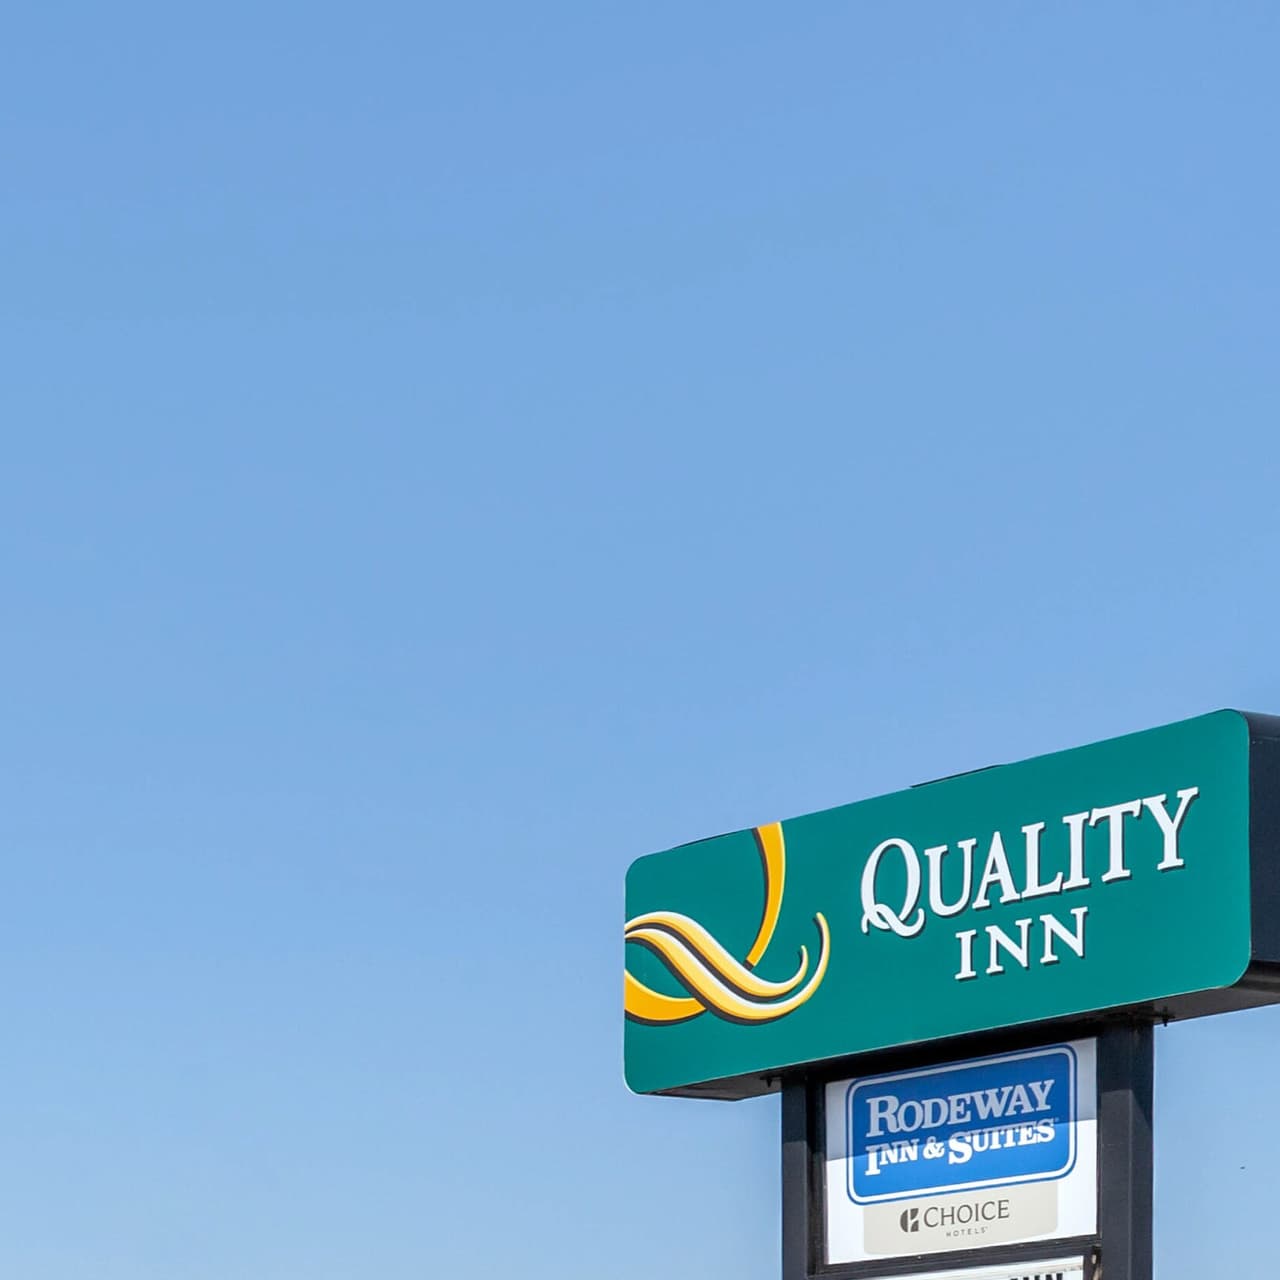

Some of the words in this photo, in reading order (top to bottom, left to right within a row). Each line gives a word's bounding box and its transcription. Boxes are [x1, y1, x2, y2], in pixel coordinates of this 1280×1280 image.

[861, 787, 1198, 937] QUALITY
[955, 907, 1088, 980] INN
[865, 1079, 1055, 1138] RODEWAY
[865, 1138, 920, 1176] INN
[923, 1136, 944, 1159] &
[948, 1118, 1055, 1164] SUITES
[923, 1199, 1010, 1229] CHOICE
[945, 1227, 986, 1237] HOTELS
